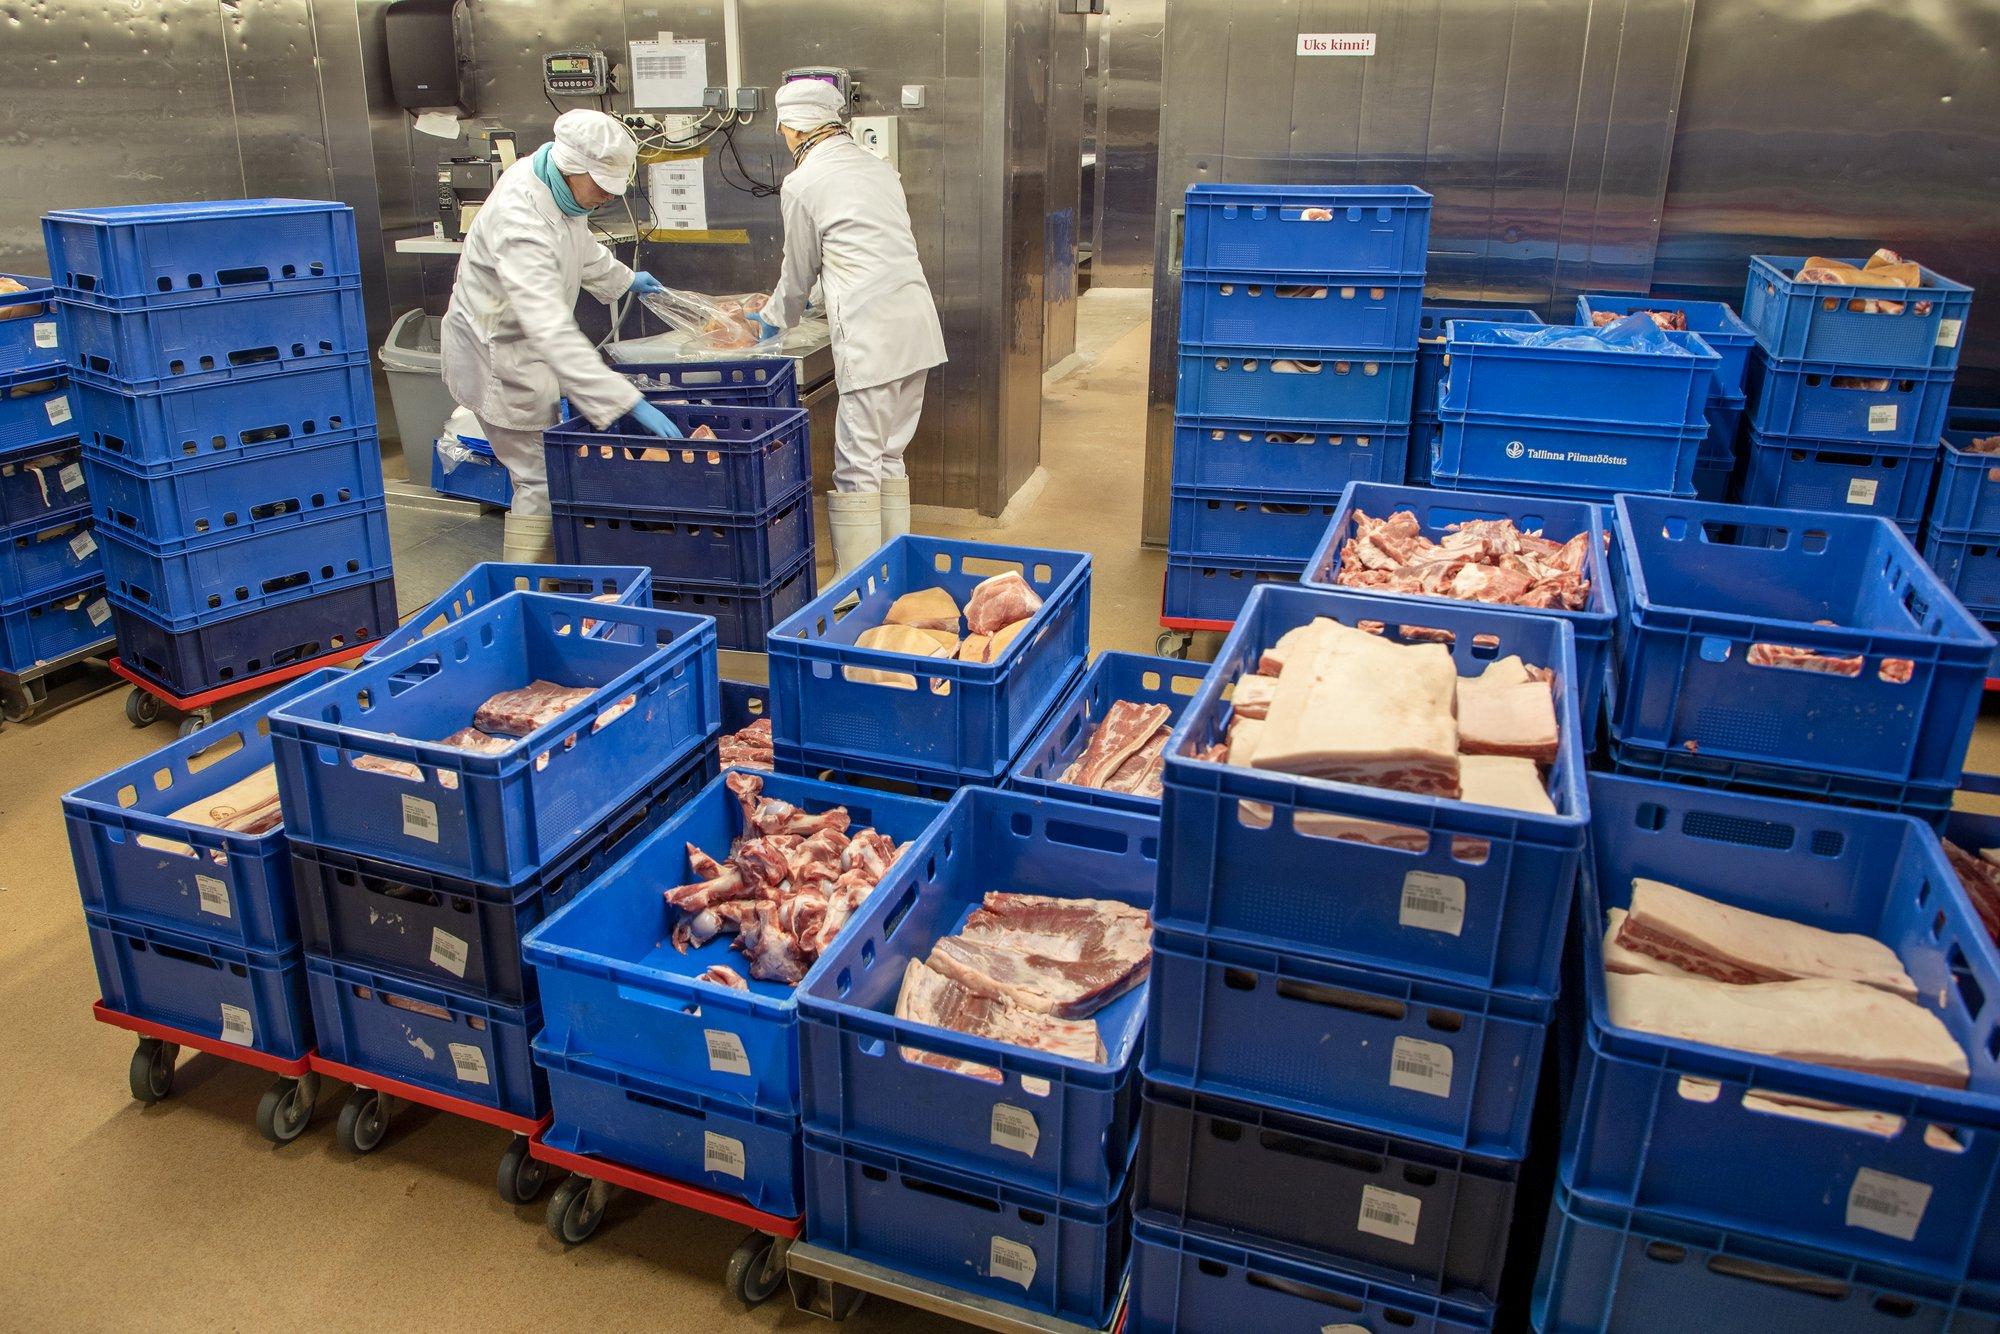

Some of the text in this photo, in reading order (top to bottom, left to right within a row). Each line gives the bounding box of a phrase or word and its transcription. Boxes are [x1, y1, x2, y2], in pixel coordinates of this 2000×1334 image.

[1304, 39, 1369, 50] Uks kinni!
[1528, 449, 1628, 466] Tallinna Piimatööstus
